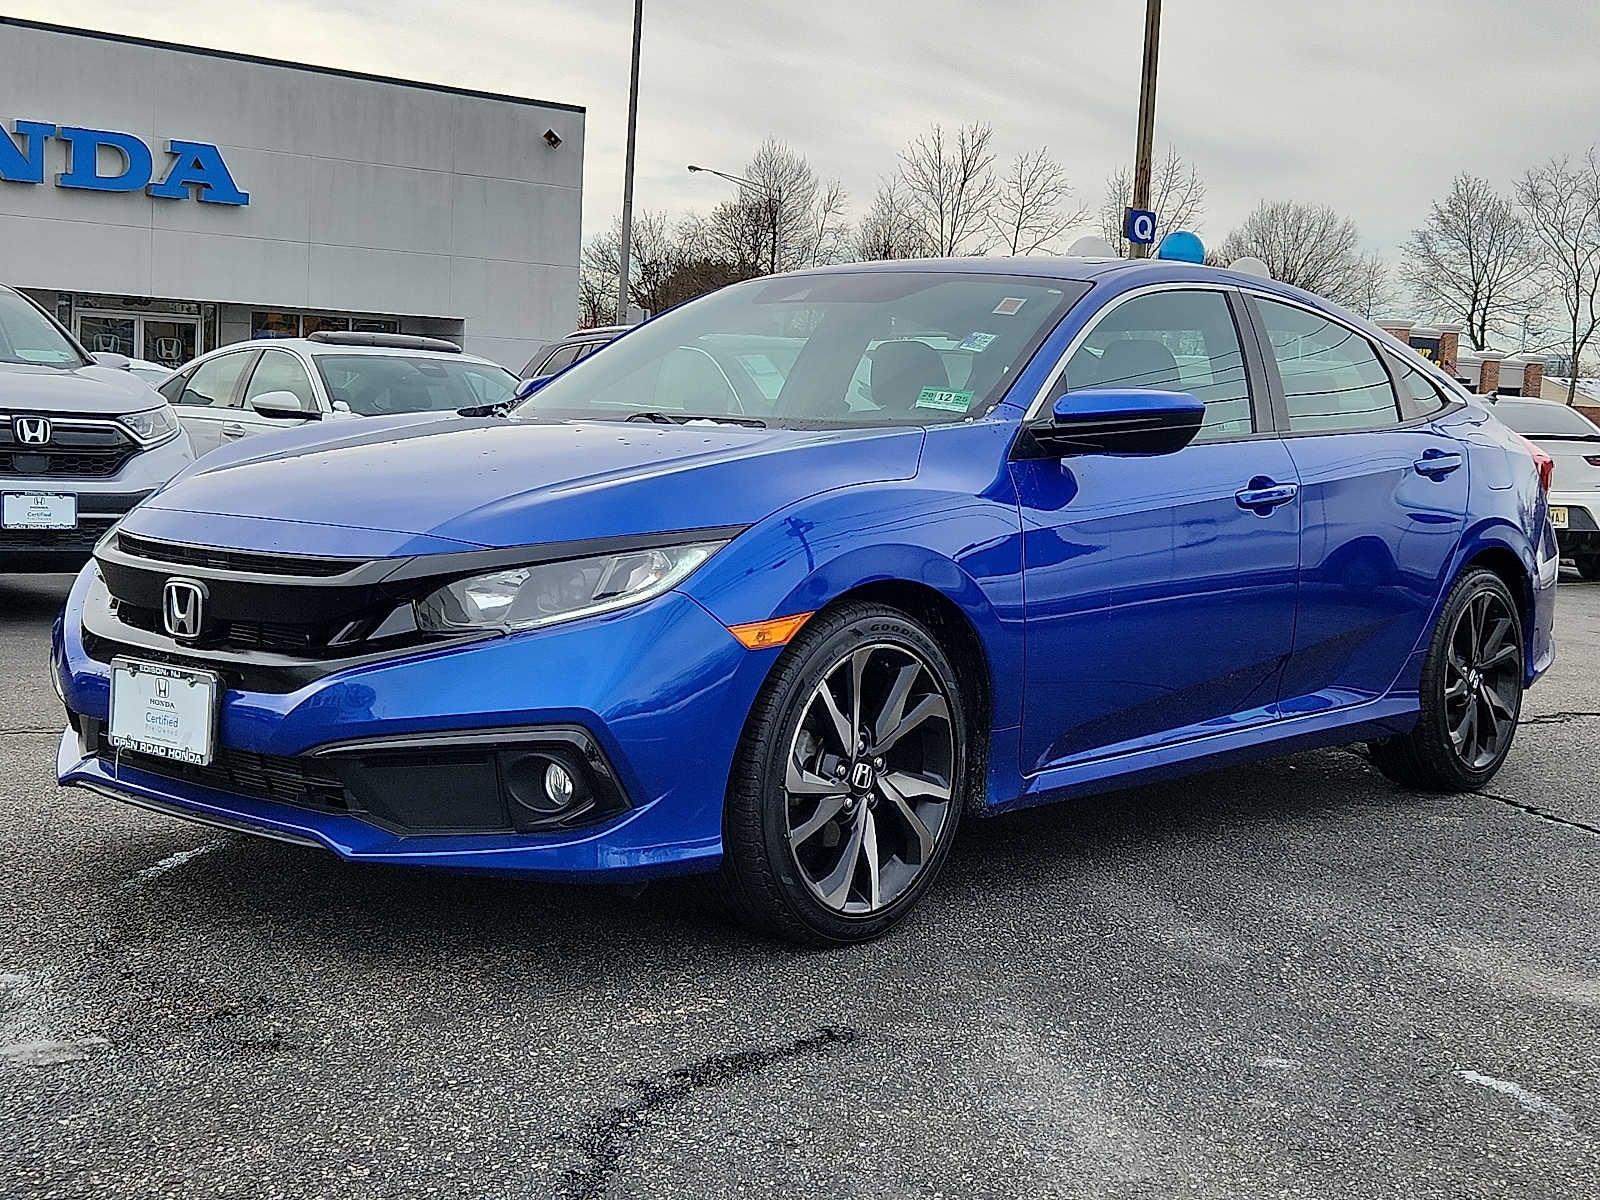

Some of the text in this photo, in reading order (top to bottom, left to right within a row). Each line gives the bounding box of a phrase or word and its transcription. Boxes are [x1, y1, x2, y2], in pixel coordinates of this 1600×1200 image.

[1134, 215, 1153, 240] Q
[938, 393, 953, 402] 12
[170, 669, 181, 678] NJ
[149, 698, 175, 709] HONDA
[145, 711, 179, 728] Certified
[113, 737, 202, 764] OPEN ROAD HONDA
